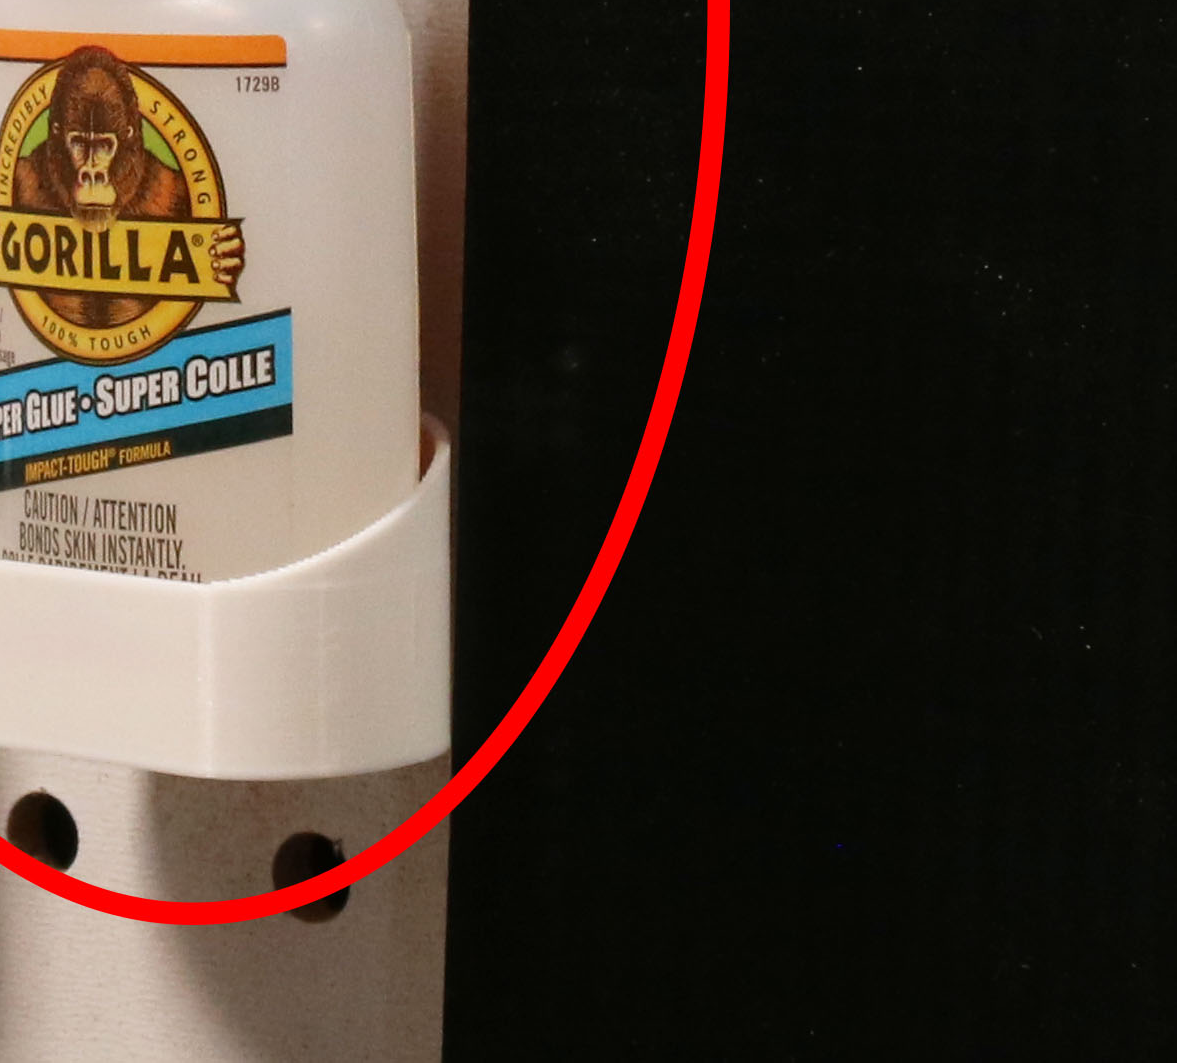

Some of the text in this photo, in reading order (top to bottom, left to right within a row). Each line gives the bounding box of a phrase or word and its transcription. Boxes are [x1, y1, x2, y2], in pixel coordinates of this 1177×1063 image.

[0, 85, 212, 205] INCREDIBLY STRONG
[41, 316, 152, 351] 100% TOUGH
[25, 388, 78, 432] GLUE
[95, 367, 181, 418] SUPER
[185, 349, 273, 400] COLLE
[119, 441, 172, 466] FORMULA
[24, 489, 78, 525] CAUTION
[93, 498, 177, 535] ATTENTION
[19, 521, 60, 557] BONDS
[64, 529, 97, 561] SKIN
[102, 534, 186, 570] INSTANTLY.
